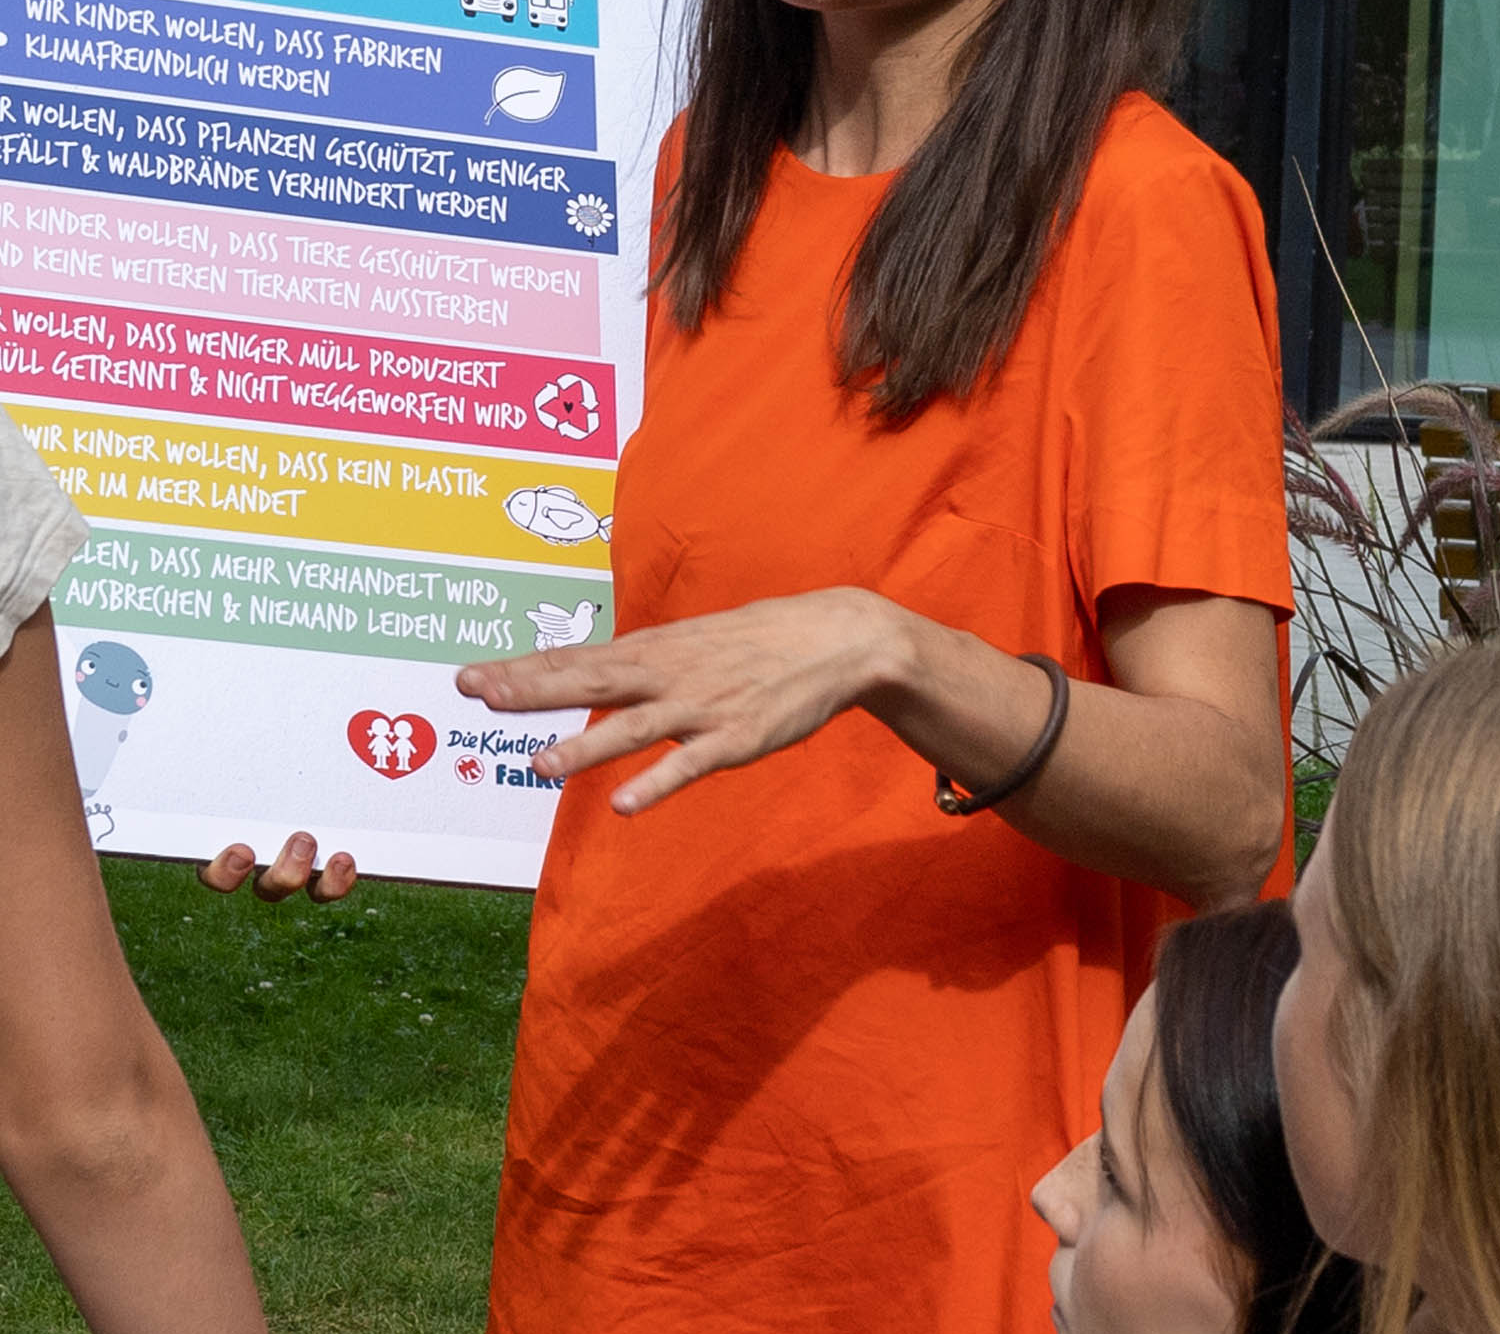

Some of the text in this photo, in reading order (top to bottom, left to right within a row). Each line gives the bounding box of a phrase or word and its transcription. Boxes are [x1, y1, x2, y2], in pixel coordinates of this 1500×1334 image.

[25, 33, 330, 98] KLIMAFREUNDLICH WERDEN
[75, 1, 161, 37] KINDER
[164, 14, 265, 56] WOLLEN,
[274, 28, 324, 60] DASS
[333, 33, 442, 75] FABRIKEN
[23, 100, 125, 142] WOLLEN,
[136, 115, 186, 147] DASS
[197, 121, 316, 162] PFLANZEN
[325, 137, 457, 184] GESCHÜTZT,
[466, 157, 571, 193] WENIGER
[81, 143, 101, 174] &
[107, 150, 260, 192] WALDBRÄNDE
[267, 169, 415, 210] VERHINDERT
[416, 189, 508, 224] WERDEN
[25, 205, 112, 241] KINDER
[116, 218, 218, 259] WOLLEN,
[228, 231, 279, 263] DASS
[285, 236, 351, 269] TIERE
[358, 245, 488, 284] GESCHÜTZT
[490, 263, 581, 297] WERDEN
[33, 245, 104, 278] KEINE
[111, 256, 228, 294] WEITEREN
[234, 268, 361, 310] TIERARTEN
[370, 285, 509, 327] AUSSTERBEN
[12, 309, 115, 351] WOLLEN,
[125, 322, 177, 354] DASS
[185, 329, 294, 366] WENIGER
[298, 339, 361, 372] MÜLL
[369, 348, 506, 388] PRODUZIERT
[51, 350, 187, 391] GETRENNT
[189, 365, 209, 397] &
[216, 369, 288, 406] NICHT
[290, 379, 465, 425] WEGGEWORFEN
[474, 401, 528, 430] WIRD
[21, 422, 488, 498] WIR KINDER WOLLEN, DASS KEIN PLASTIK
[46, 464, 307, 517] EHR IM MEER LANDET
[65, 577, 212, 620] AUSBRECHEN
[222, 592, 242, 623] &
[250, 594, 358, 633] NIEMAND
[367, 608, 447, 643] LEIDEN
[455, 618, 514, 651] MUSS
[150, 546, 201, 579] DASS
[210, 553, 281, 585] MEHR
[286, 559, 443, 600] VERHANDELT
[445, 578, 508, 614] WIRD,
[447, 729, 477, 748] Die
